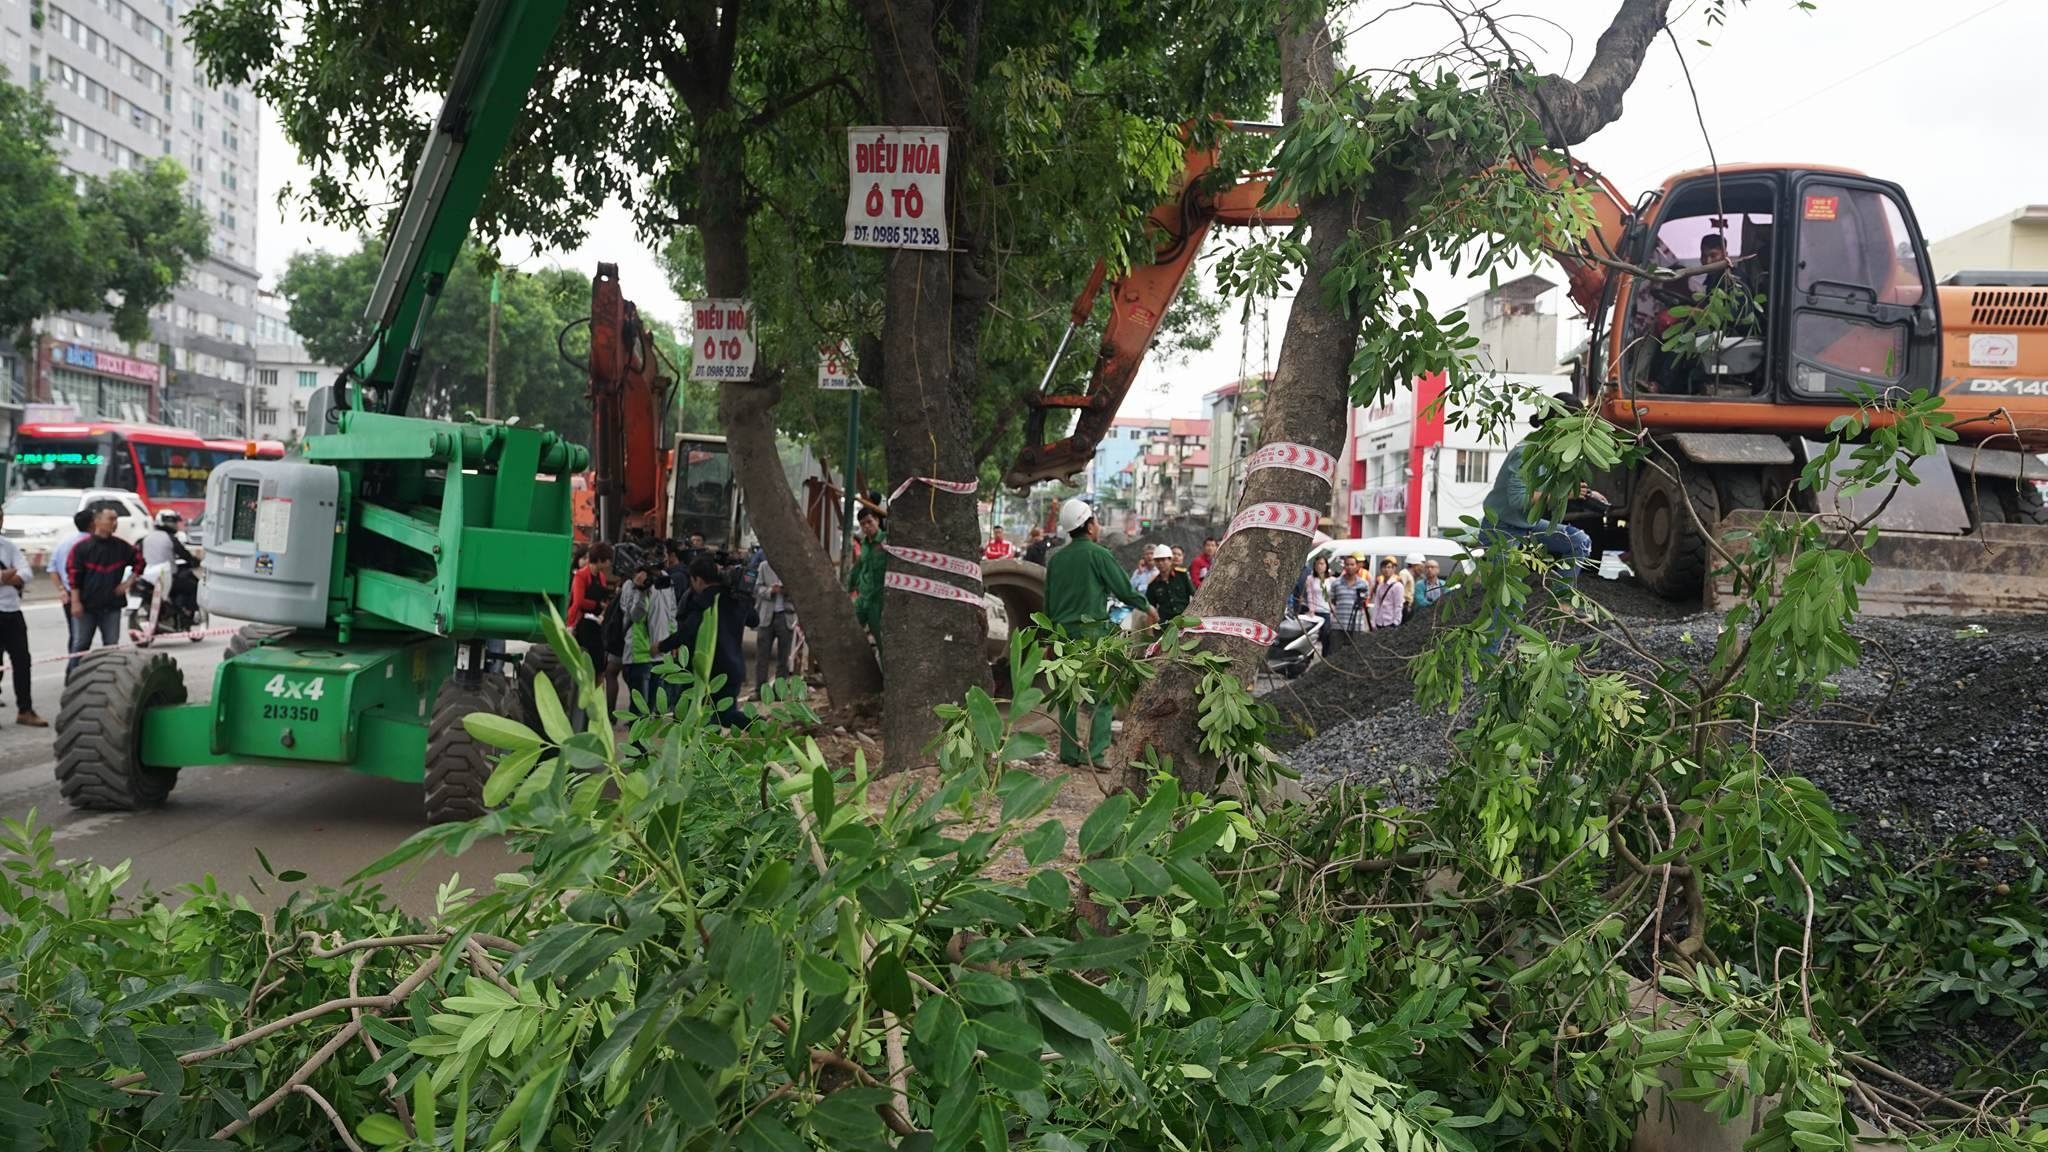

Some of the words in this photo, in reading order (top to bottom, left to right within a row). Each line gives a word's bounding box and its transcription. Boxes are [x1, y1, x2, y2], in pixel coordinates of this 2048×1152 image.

[902, 136, 940, 174] HÒA
[865, 182, 884, 217] Ô
[891, 183, 924, 219] TÔ
[854, 225, 869, 241] ĐT:
[872, 226, 900, 244] 0986
[902, 226, 919, 244] 512
[921, 227, 940, 245] 358
[704, 336, 715, 360] Ô
[720, 336, 741, 360] TÔ
[706, 365, 724, 377] 0986
[724, 365, 735, 377] 512
[1969, 377, 2017, 392] DX
[264, 673, 324, 701] 4x4
[263, 704, 319, 722] 213350
